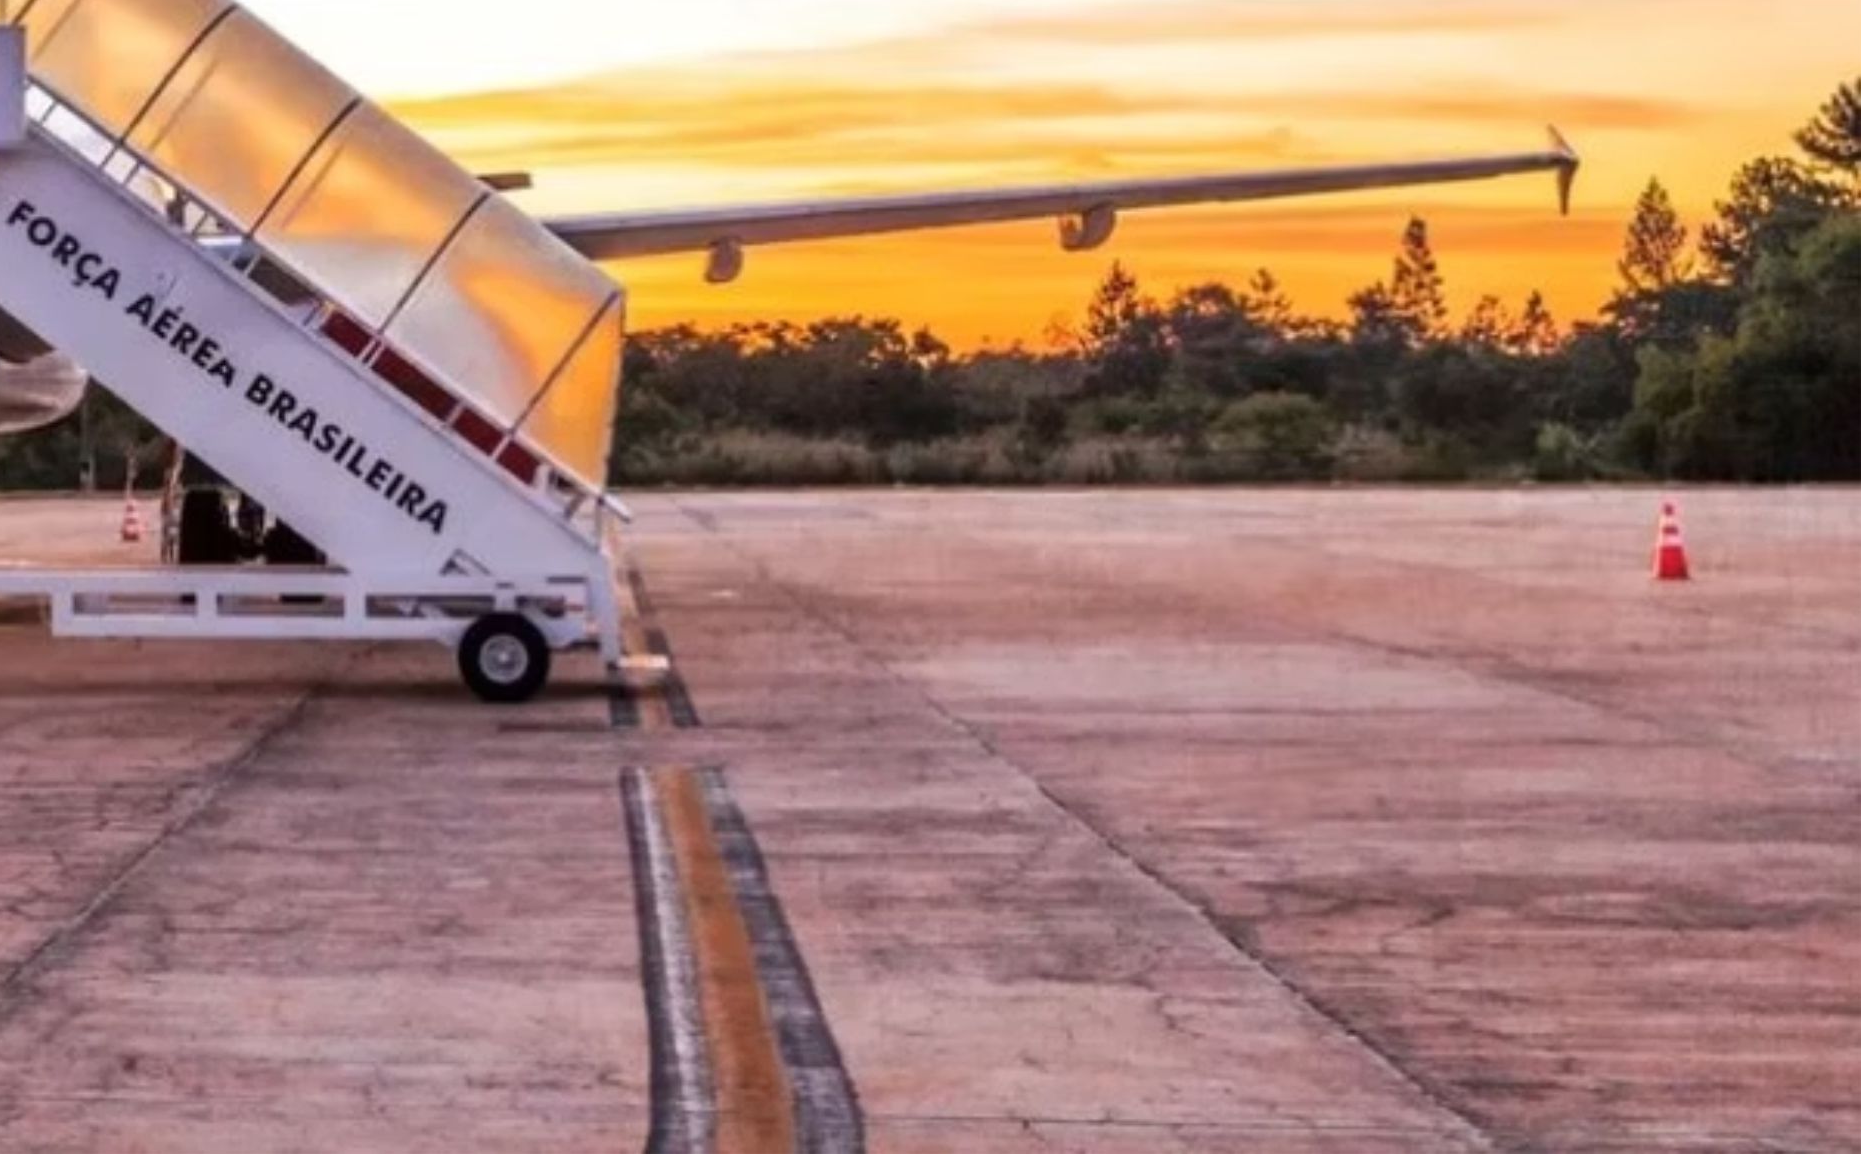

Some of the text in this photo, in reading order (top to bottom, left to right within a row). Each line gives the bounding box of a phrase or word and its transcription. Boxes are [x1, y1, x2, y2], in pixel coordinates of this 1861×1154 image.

[6, 200, 448, 535] FORÇA AÉREA BRASILEIRA
